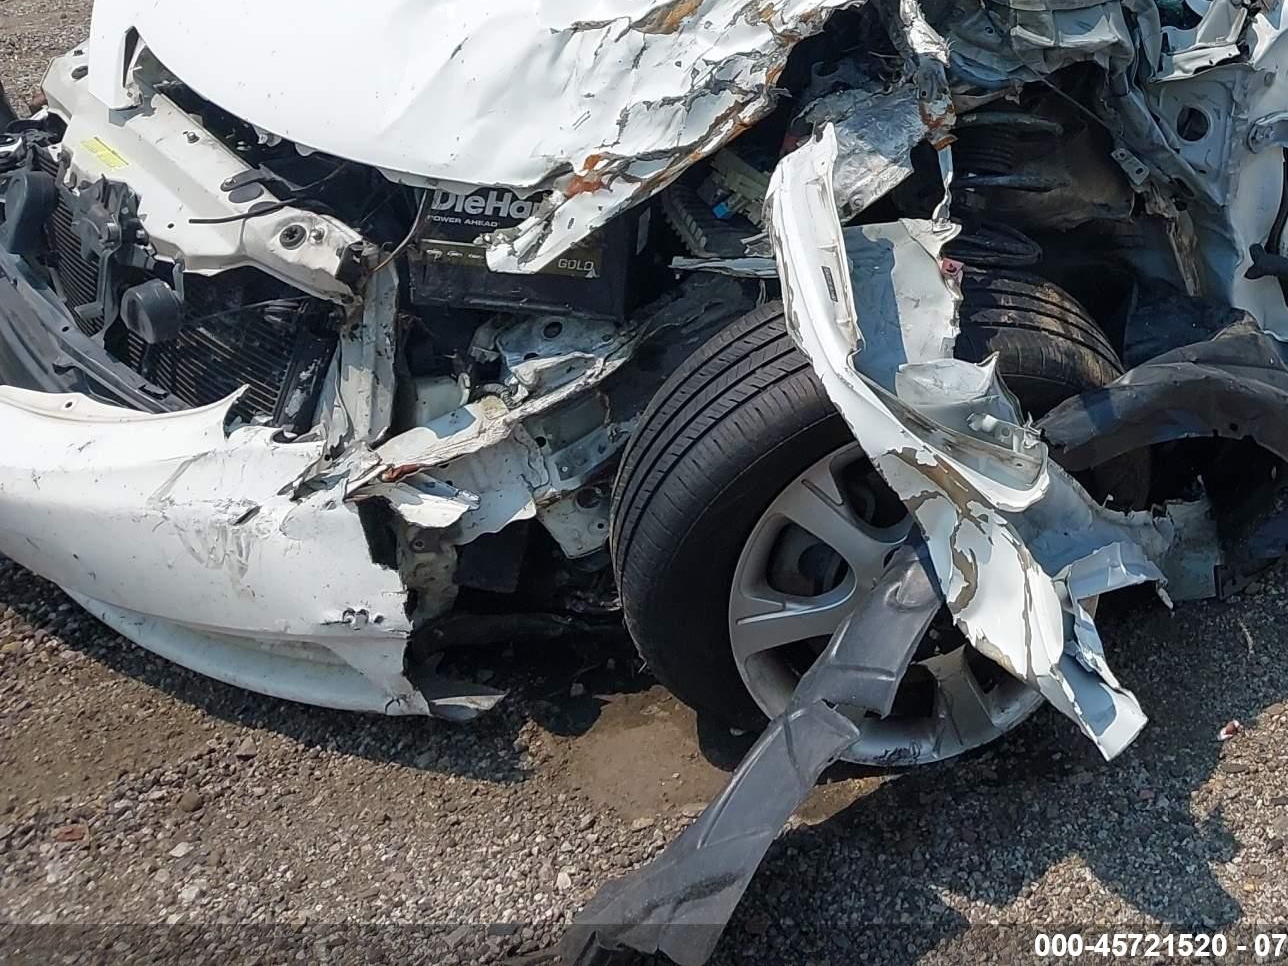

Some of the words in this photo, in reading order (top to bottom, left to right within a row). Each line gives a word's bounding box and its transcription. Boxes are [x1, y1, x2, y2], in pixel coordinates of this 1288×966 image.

[431, 189, 541, 220] DieHa
[426, 215, 462, 225] POWER
[463, 218, 499, 228] AHEAD
[558, 258, 594, 271] GOLD
